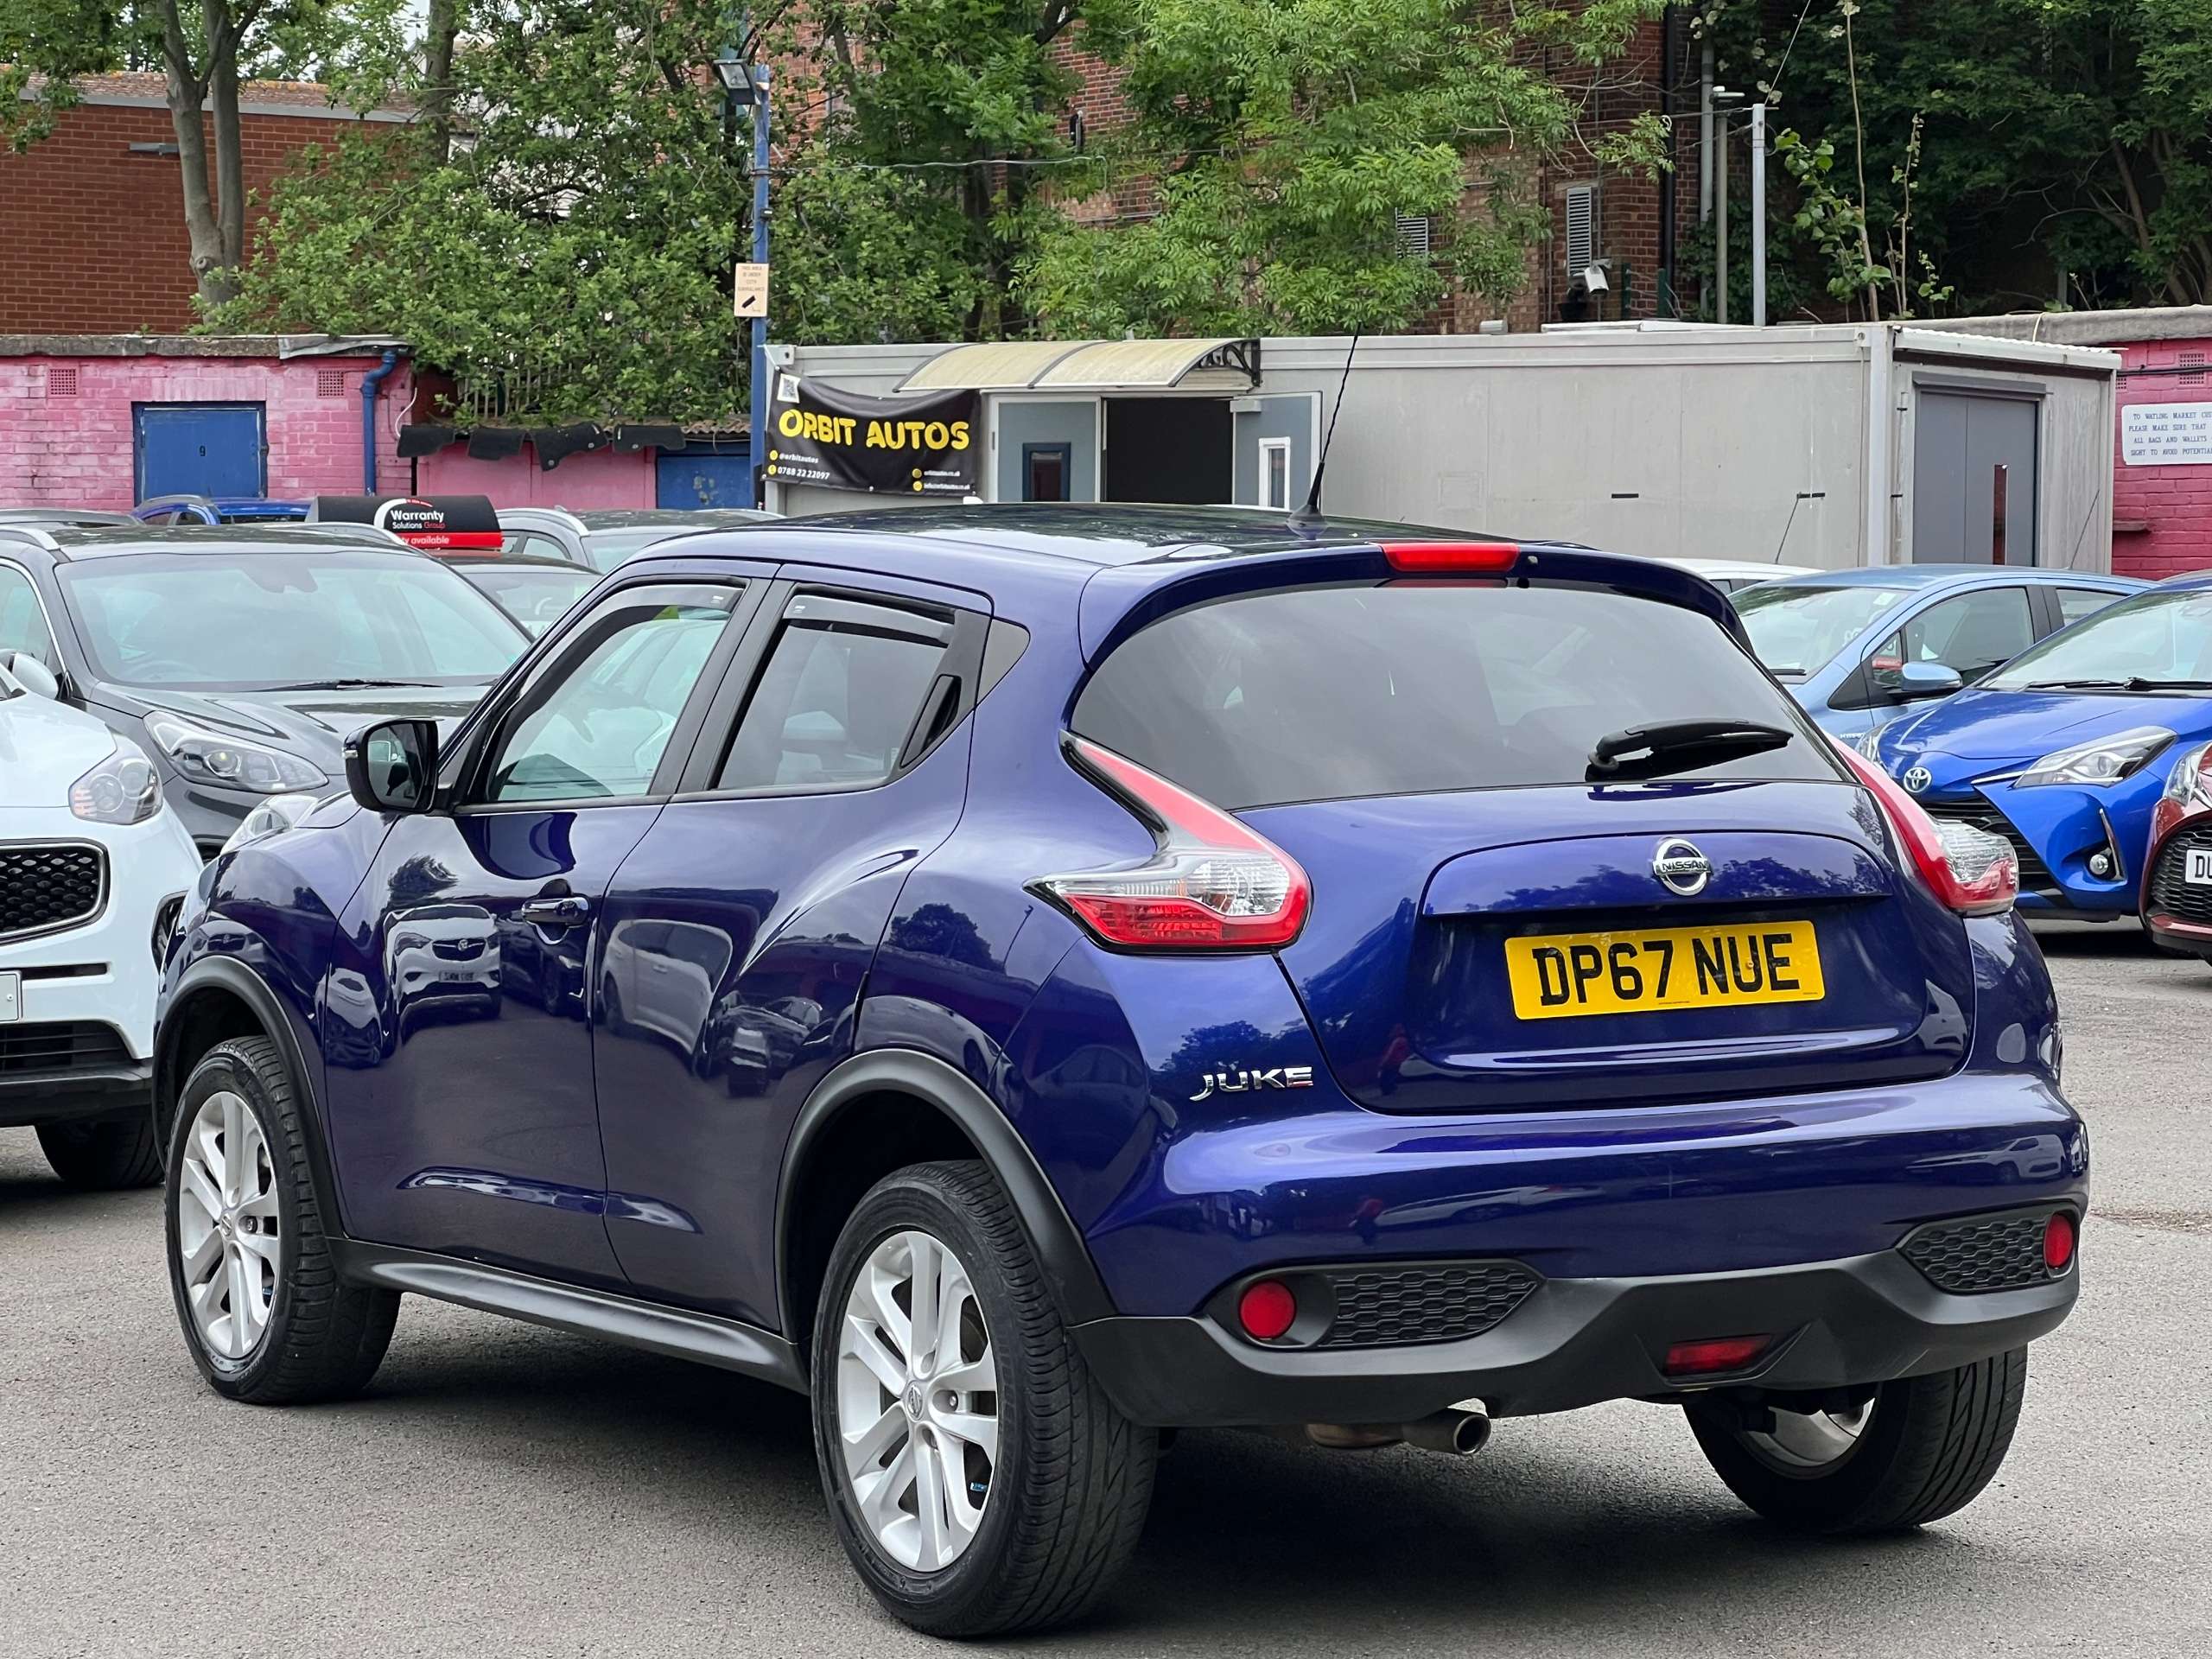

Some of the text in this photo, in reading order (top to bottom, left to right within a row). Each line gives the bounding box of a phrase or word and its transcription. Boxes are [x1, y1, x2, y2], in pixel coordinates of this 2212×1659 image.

[779, 409, 969, 450] ORBIT AUTOS
[199, 445, 207, 457] 9
[779, 453, 819, 464] @orbitautos
[390, 510, 445, 524] Warranty
[391, 521, 447, 530] Solutions Group
[410, 536, 450, 545] available
[1662, 861, 1708, 872] NISSAN
[1532, 933, 1801, 1007] DP67 NUE
[1189, 1066, 1314, 1102] JUKE
